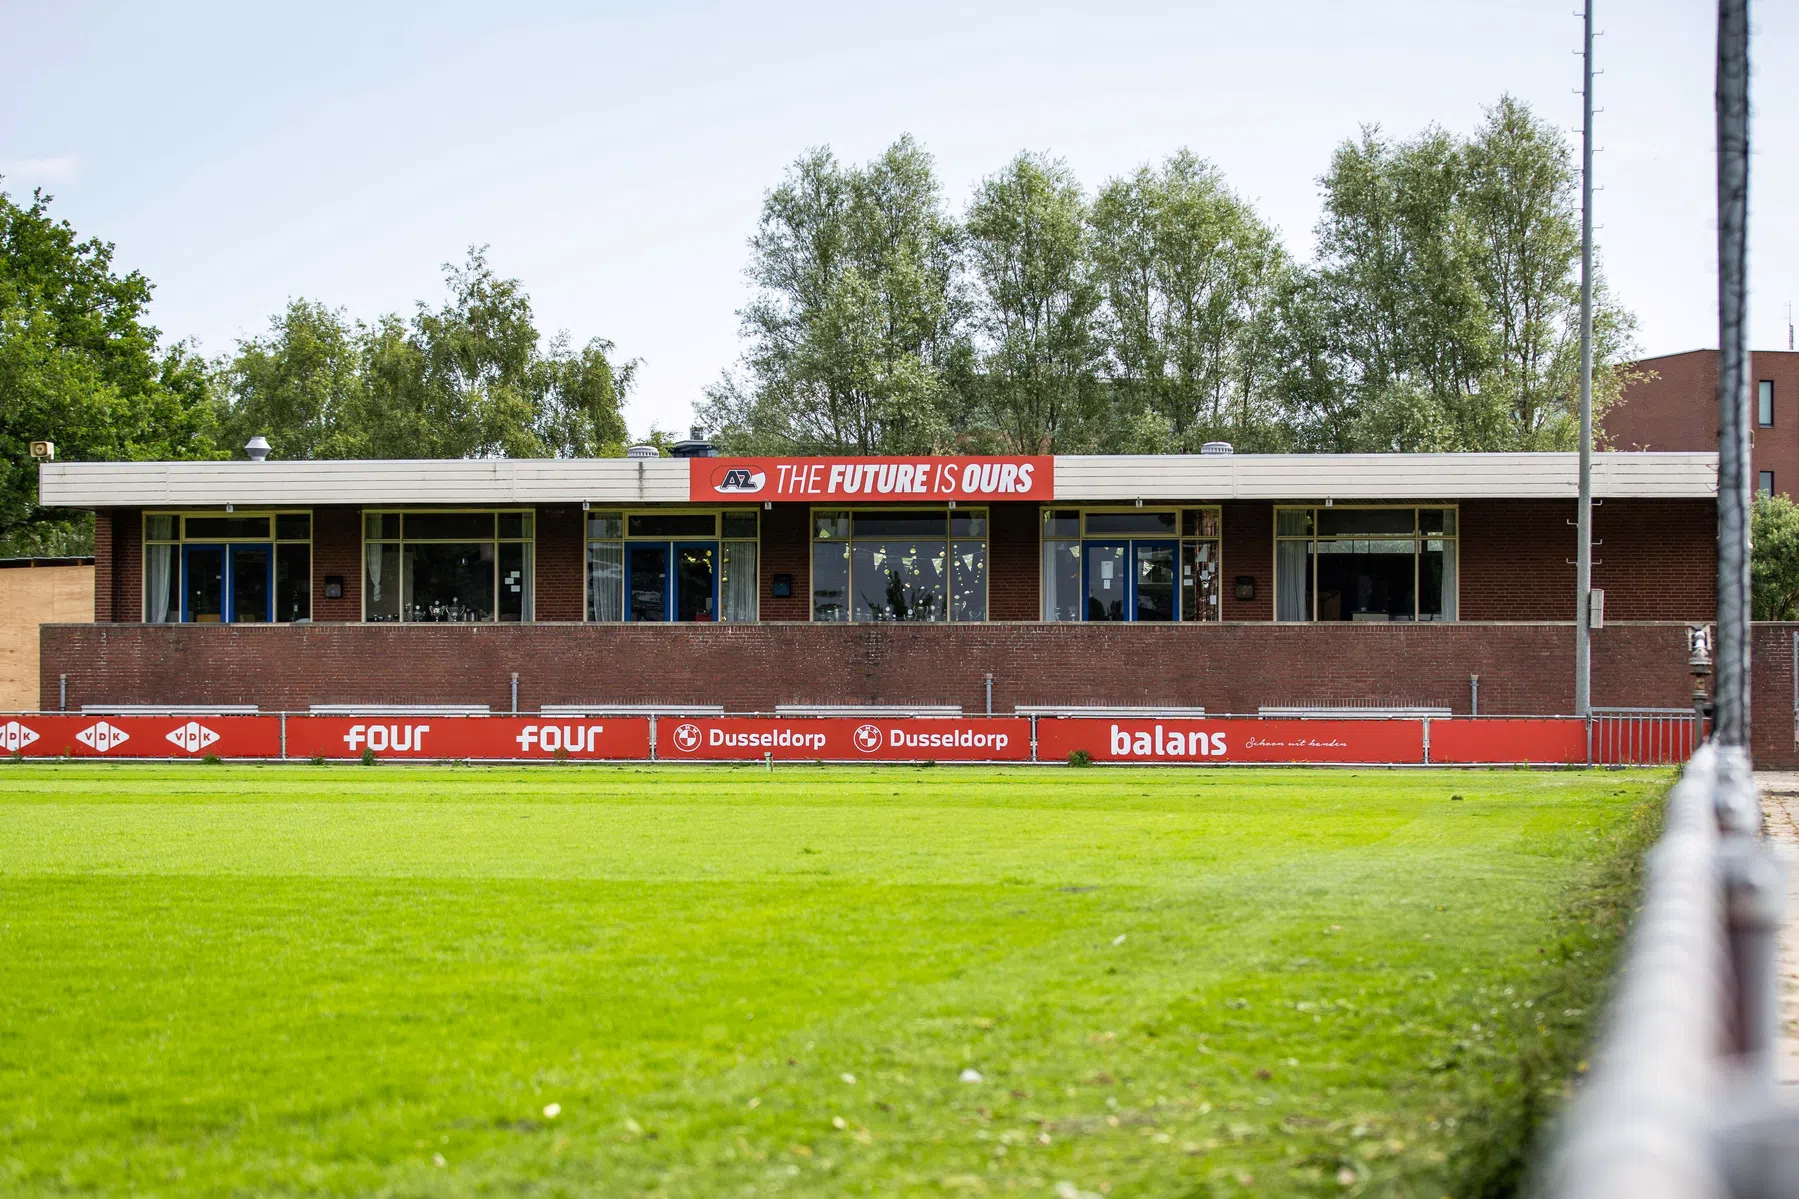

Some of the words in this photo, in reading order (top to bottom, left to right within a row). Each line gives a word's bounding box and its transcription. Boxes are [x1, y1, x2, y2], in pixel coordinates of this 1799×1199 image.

[720, 469, 757, 490] AZ
[776, 464, 825, 494] THE
[827, 464, 928, 494] FUTURE
[933, 464, 959, 494] IS
[961, 463, 1034, 494] OURS
[84, 732, 121, 741] VDK
[175, 732, 211, 742] VDK
[709, 727, 826, 750] Dusseldorp
[890, 728, 1008, 751] Dusseldorp
[1110, 724, 1227, 756] balans
